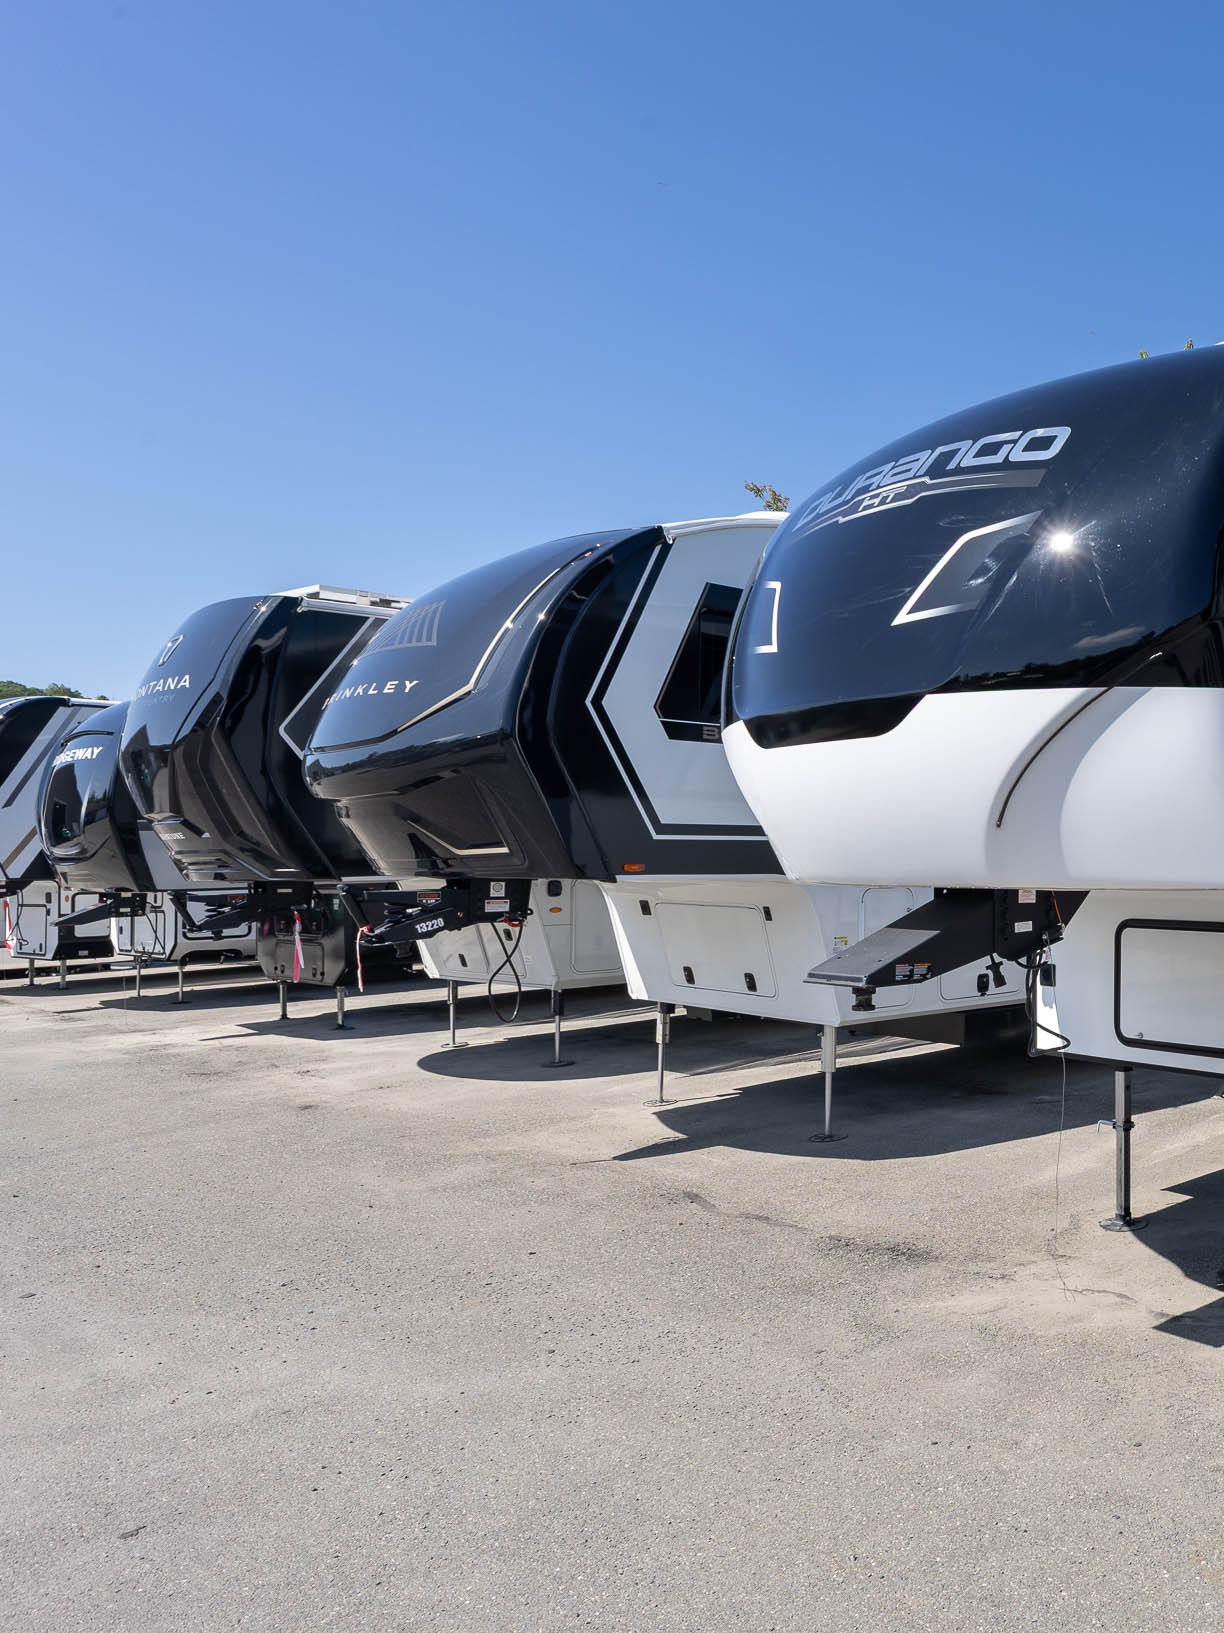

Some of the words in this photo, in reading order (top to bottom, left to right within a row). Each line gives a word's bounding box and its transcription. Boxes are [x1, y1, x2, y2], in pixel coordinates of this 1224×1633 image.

[857, 486, 907, 512] HT
[136, 675, 190, 698] ONTANA
[415, 918, 444, 933] 13220
